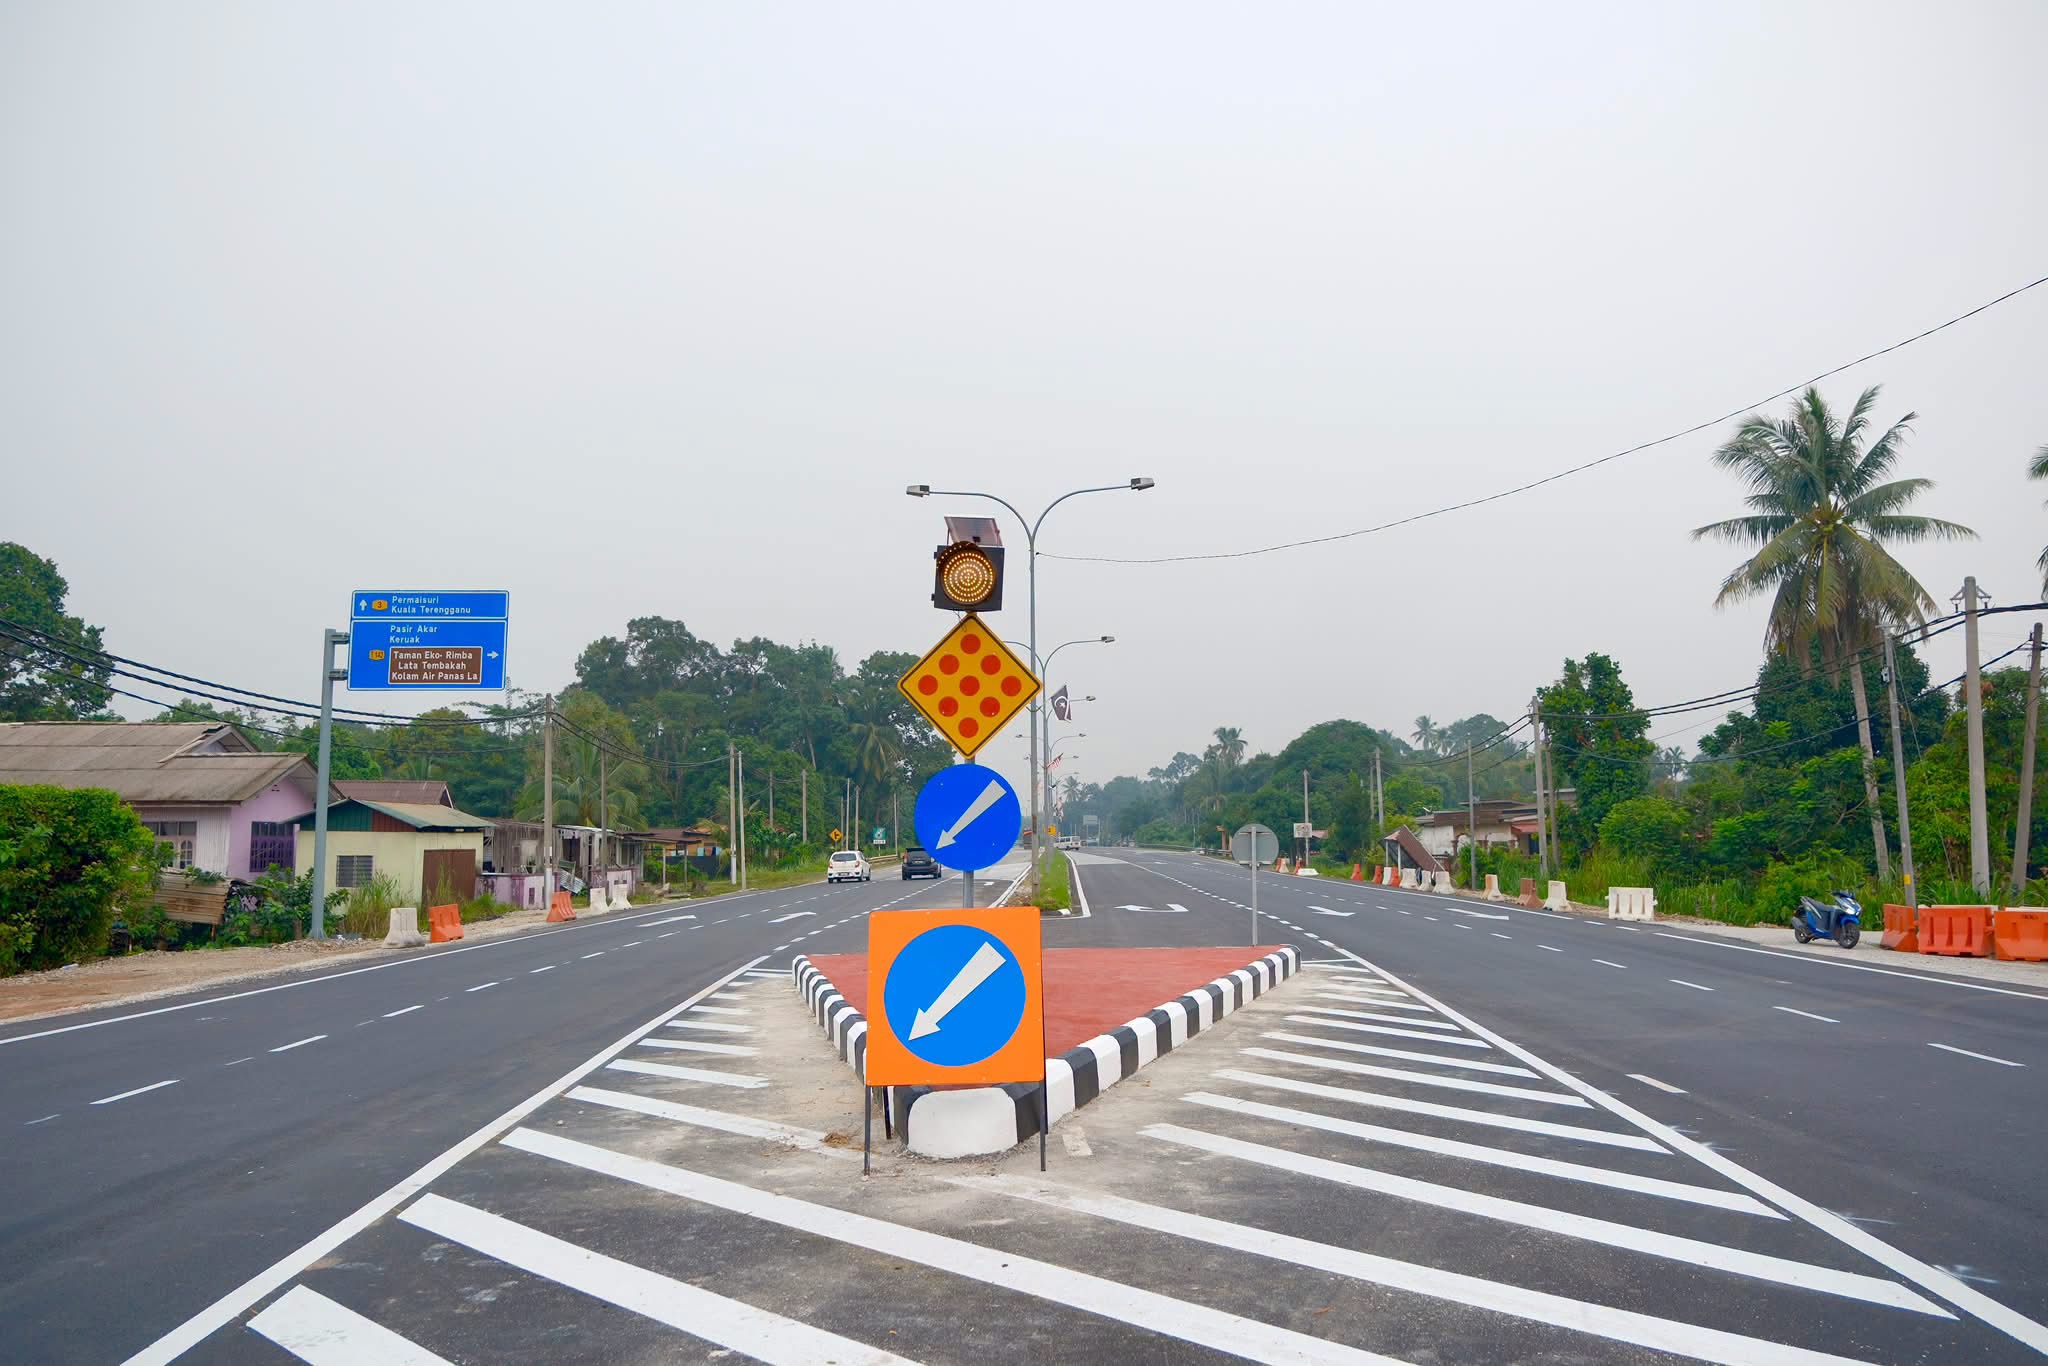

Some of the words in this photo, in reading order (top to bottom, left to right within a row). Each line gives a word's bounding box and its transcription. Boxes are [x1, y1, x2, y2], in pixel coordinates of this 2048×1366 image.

[392, 596, 439, 604] Permaisuri
[391, 605, 416, 614] Kuala
[420, 605, 471, 615] Terengganu
[390, 625, 412, 633] Pasir
[417, 625, 437, 633] Akar
[389, 635, 420, 643] Keruak
[393, 651, 422, 659] Taman
[446, 651, 473, 659] Rimba
[398, 661, 418, 670] Lata
[422, 661, 466, 670] Tembakah
[391, 672, 419, 680] Kolam
[422, 672, 435, 680] Air
[438, 672, 464, 680] Panas
[467, 672, 478, 680] La
